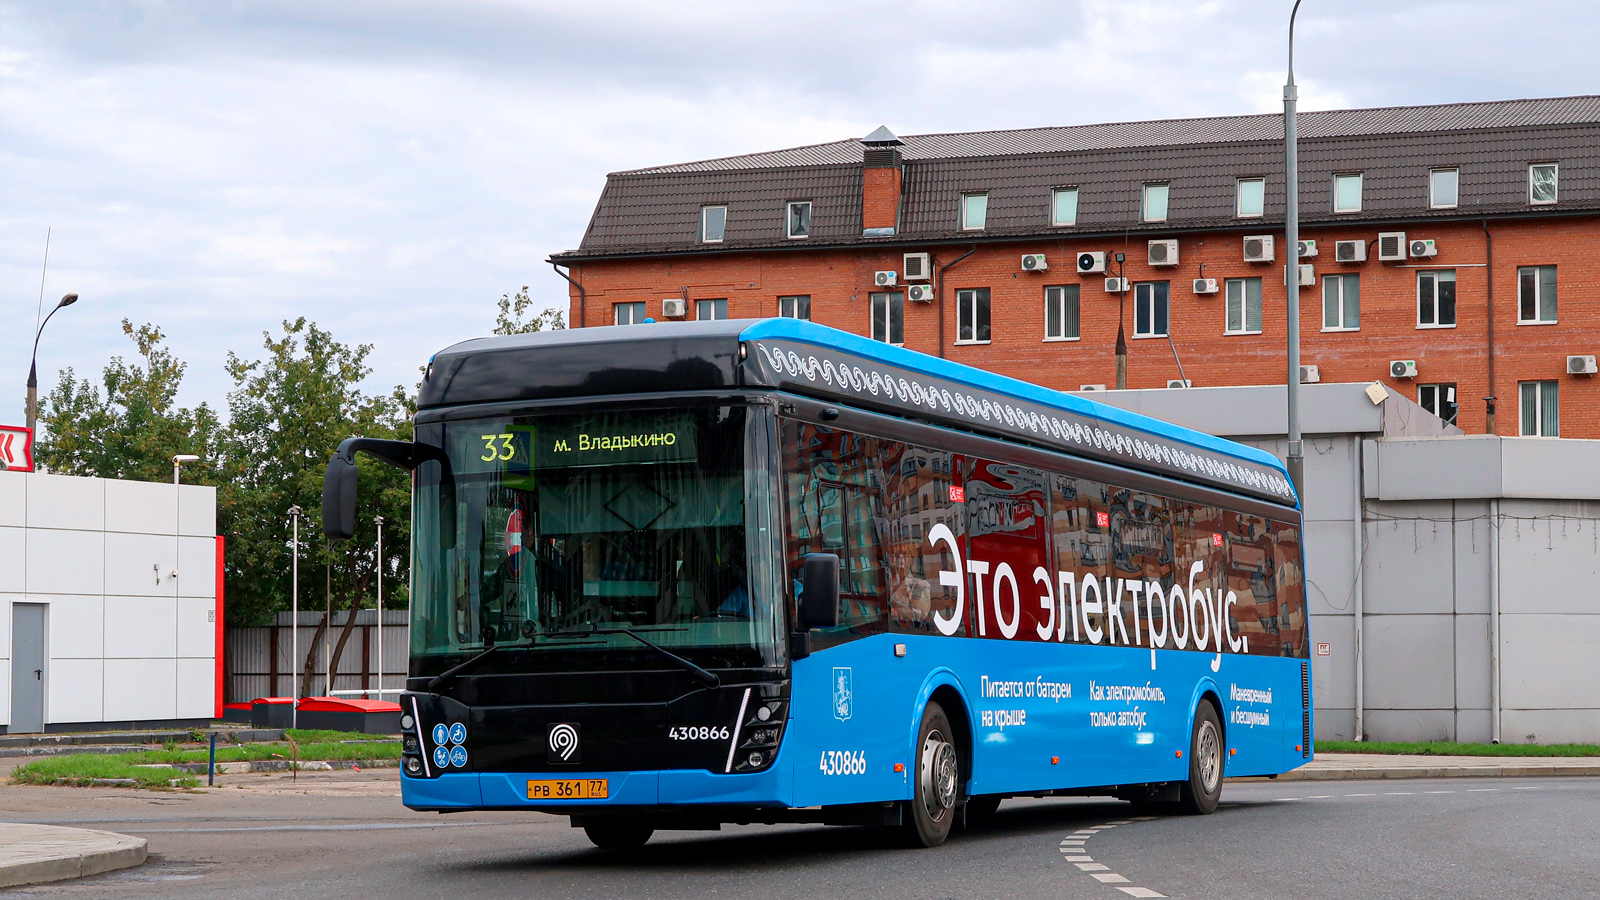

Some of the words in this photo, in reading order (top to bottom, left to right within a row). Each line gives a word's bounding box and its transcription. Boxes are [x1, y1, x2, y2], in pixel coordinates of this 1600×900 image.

[480, 433, 515, 462] 33
[553, 439, 572, 453] м.
[578, 432, 676, 452] Владыкино
[927, 522, 1020, 640] Это
[1032, 559, 1249, 673] электробус.
[980, 675, 1024, 698] Питается
[1025, 681, 1036, 698] от
[1036, 675, 1072, 704] батареи
[1089, 680, 1106, 701] Как
[1106, 680, 1166, 705] электромобиль,
[1230, 683, 1273, 706] Маневренный
[981, 709, 993, 727] на
[994, 709, 1027, 731] крыше
[1089, 711, 1117, 728] только
[1117, 705, 1147, 731] автобус
[1230, 710, 1236, 724] и
[1235, 705, 1270, 729] бесшумный
[669, 726, 730, 741] 430866
[819, 750, 867, 776] 430866
[556, 781, 581, 796] 361
[589, 780, 603, 792] 77
